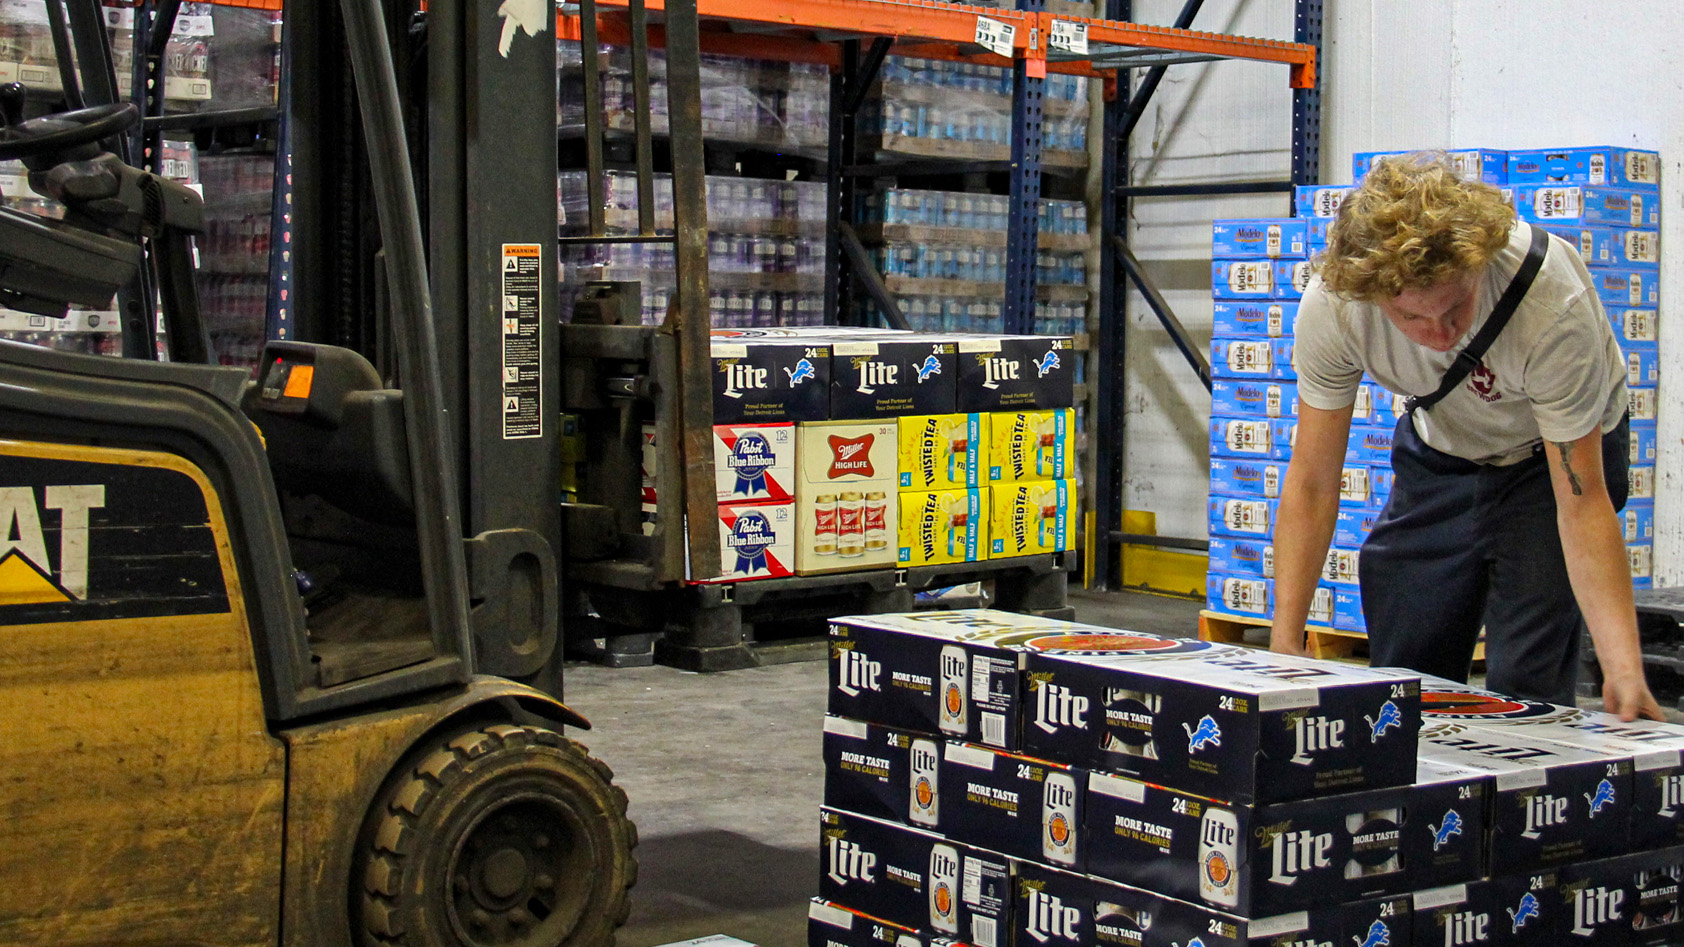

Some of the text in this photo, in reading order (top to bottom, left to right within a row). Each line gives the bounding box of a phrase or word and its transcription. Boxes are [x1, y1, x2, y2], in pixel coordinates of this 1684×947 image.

[1321, 190, 1330, 216] Modelo
[1544, 190, 1552, 217] Modelo
[1238, 228, 1261, 238] Modelo
[1238, 264, 1246, 291] Modelo
[1239, 308, 1261, 318] Modelo
[805, 348, 816, 357] 24
[933, 344, 943, 354] 24
[1052, 340, 1062, 349] 24
[717, 358, 740, 372] Miller
[1236, 343, 1245, 370] Modelo
[723, 364, 767, 398] Lite
[856, 361, 897, 394] Lite
[982, 358, 1019, 389] Lite
[1238, 387, 1260, 397] Modelo
[776, 430, 787, 440] 12
[1235, 423, 1244, 449] Modelo
[1367, 434, 1393, 445] Modelo
[739, 439, 763, 454] Pabst
[838, 443, 864, 460] Miller
[923, 419, 937, 486] TWISTED TEA
[1013, 414, 1025, 480] TWISTED TEA
[728, 455, 774, 467] Blue Ribbon
[1236, 465, 1258, 476] Modelo
[776, 508, 787, 519] 12
[1015, 487, 1027, 552] TWISTED TEA
[1233, 502, 1242, 529] Modelo
[739, 518, 763, 533] Pabst
[923, 494, 937, 561] TWISTED TEA
[0, 484, 105, 600] AT
[728, 534, 774, 546] Blue Ribbon
[1235, 545, 1257, 557] Modelo
[1329, 551, 1338, 580] Modelo
[1232, 580, 1240, 608] Modelo
[1337, 595, 1346, 603] 24
[829, 625, 838, 635] 24
[832, 640, 856, 659] Miller
[838, 648, 881, 697] Lite
[943, 655, 964, 680] Lite
[1203, 659, 1339, 679] Lite
[892, 672, 932, 685] MORE TASTE
[1027, 670, 1055, 692] Miller
[1391, 684, 1404, 698] 24
[1034, 680, 1089, 734] Lite
[1219, 696, 1233, 710] 24
[1106, 709, 1152, 725] MORE TASTE
[887, 733, 898, 747] 24
[1290, 716, 1344, 766] Lite
[1428, 738, 1560, 760] Lite
[841, 751, 890, 770] MORE TASTE
[841, 761, 888, 777] ONLY CALORIES
[912, 749, 935, 774] Lite
[1607, 763, 1618, 776] 24
[1016, 764, 1030, 780] 24
[967, 782, 1018, 803] MORE TASTE
[967, 793, 981, 803] ONLY
[990, 799, 1018, 811] CALORIES
[1046, 782, 1072, 810] Lite
[1458, 786, 1471, 800] 24
[1657, 775, 1684, 818] Lit
[1172, 798, 1186, 814] 24
[1115, 815, 1172, 839] MORE TASTE
[1521, 795, 1567, 840] Lite
[1114, 827, 1170, 848] ONLY 96 CALORIES
[1203, 818, 1234, 848] Lite
[1255, 819, 1292, 849] Miller
[1353, 830, 1399, 845] MORE TASTE
[828, 835, 876, 886] Lite
[932, 853, 956, 879] Lite
[1268, 829, 1333, 885] Lite
[886, 864, 902, 876] MORE
[903, 869, 921, 882] TASTE
[1020, 877, 1046, 898] Miller
[1530, 876, 1543, 890] 24
[1641, 885, 1678, 899] MORE TASTE
[1025, 886, 1080, 942] Lite
[1380, 902, 1394, 917] 24
[1571, 886, 1624, 936] Lite
[873, 926, 883, 940] 24
[1096, 924, 1118, 935] MORE
[1119, 928, 1142, 940] TASTE
[1208, 918, 1222, 935] 24
[1445, 911, 1489, 947] Lite
